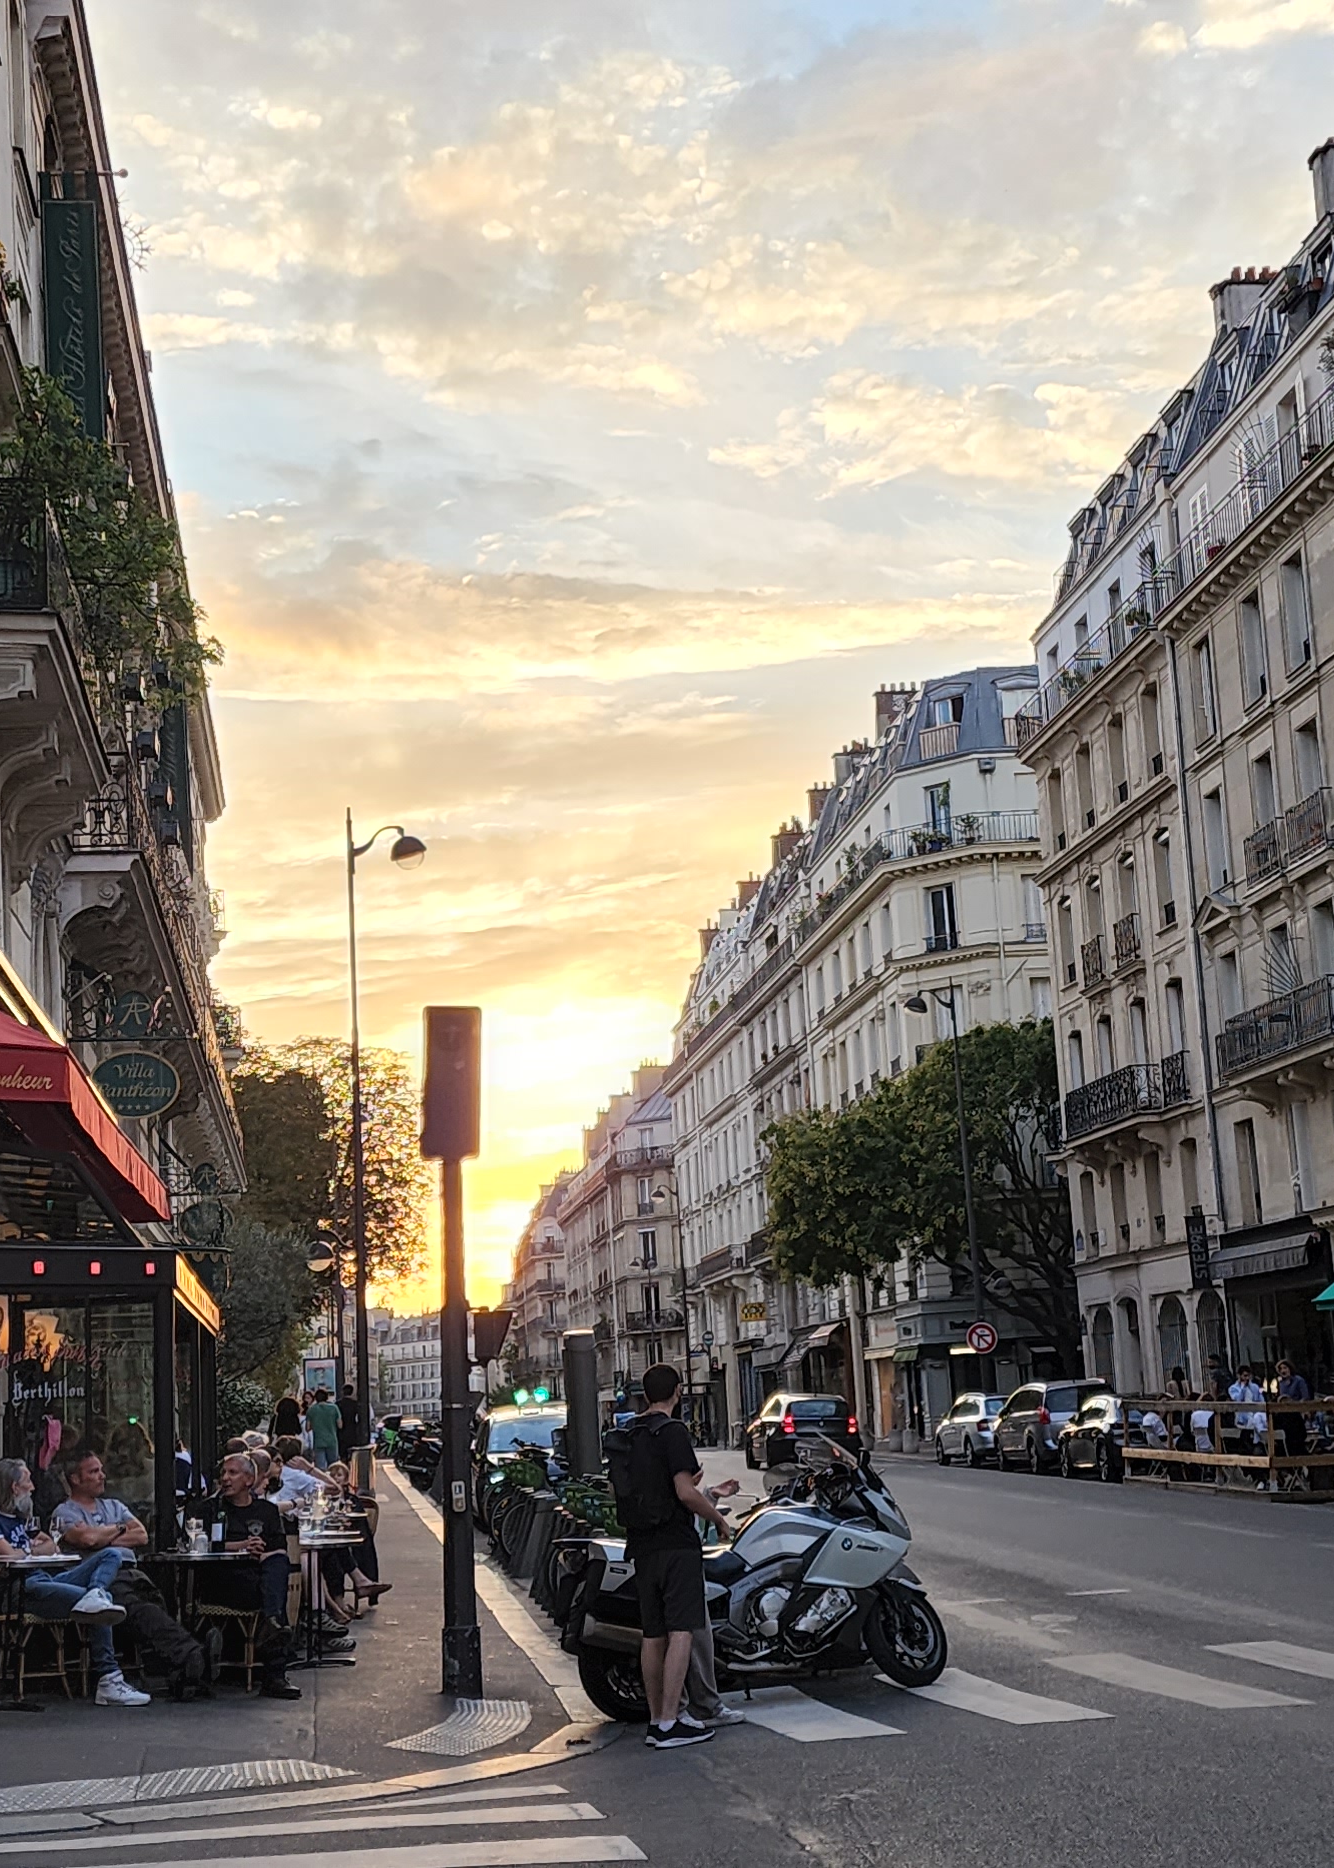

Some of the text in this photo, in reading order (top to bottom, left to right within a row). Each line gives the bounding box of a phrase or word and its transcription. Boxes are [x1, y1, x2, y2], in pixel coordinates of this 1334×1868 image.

[58, 209, 82, 271] Paris
[113, 1062, 156, 1079] Villa
[11, 1379, 86, 1407] Berthillon
